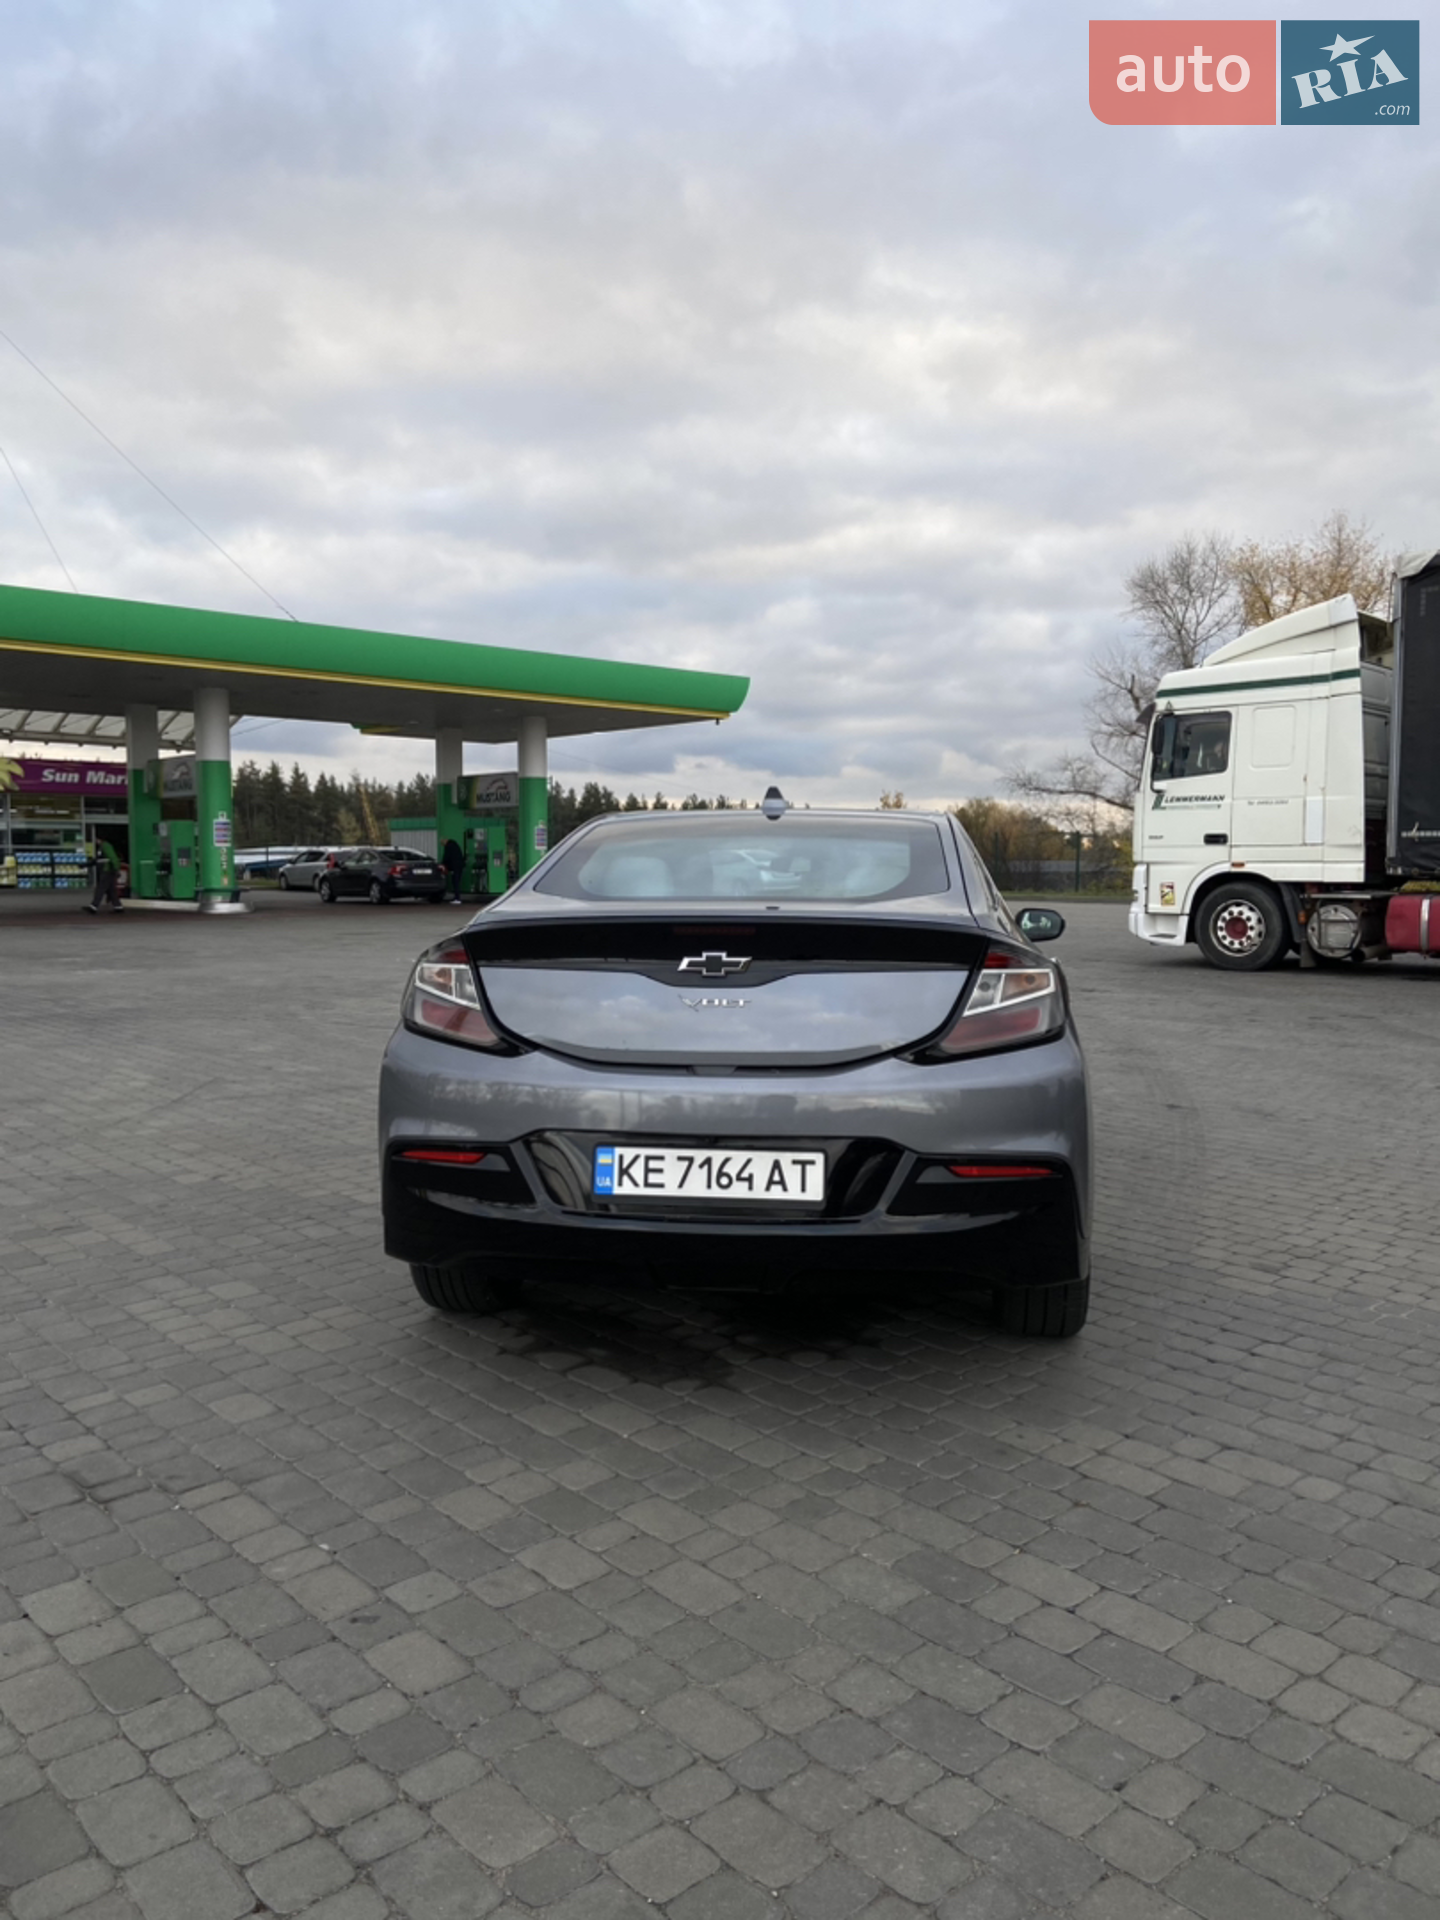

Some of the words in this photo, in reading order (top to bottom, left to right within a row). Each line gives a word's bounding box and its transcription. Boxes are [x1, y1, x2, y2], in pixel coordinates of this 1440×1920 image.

[41, 768, 80, 783] Sun
[85, 770, 128, 785] Mar
[476, 790, 511, 803] MUSTANG
[677, 993, 752, 1012] VOLT
[596, 1176, 612, 1187] UA
[617, 1153, 666, 1189] KE
[676, 1155, 754, 1192] 7164
[764, 1158, 817, 1194] AT
